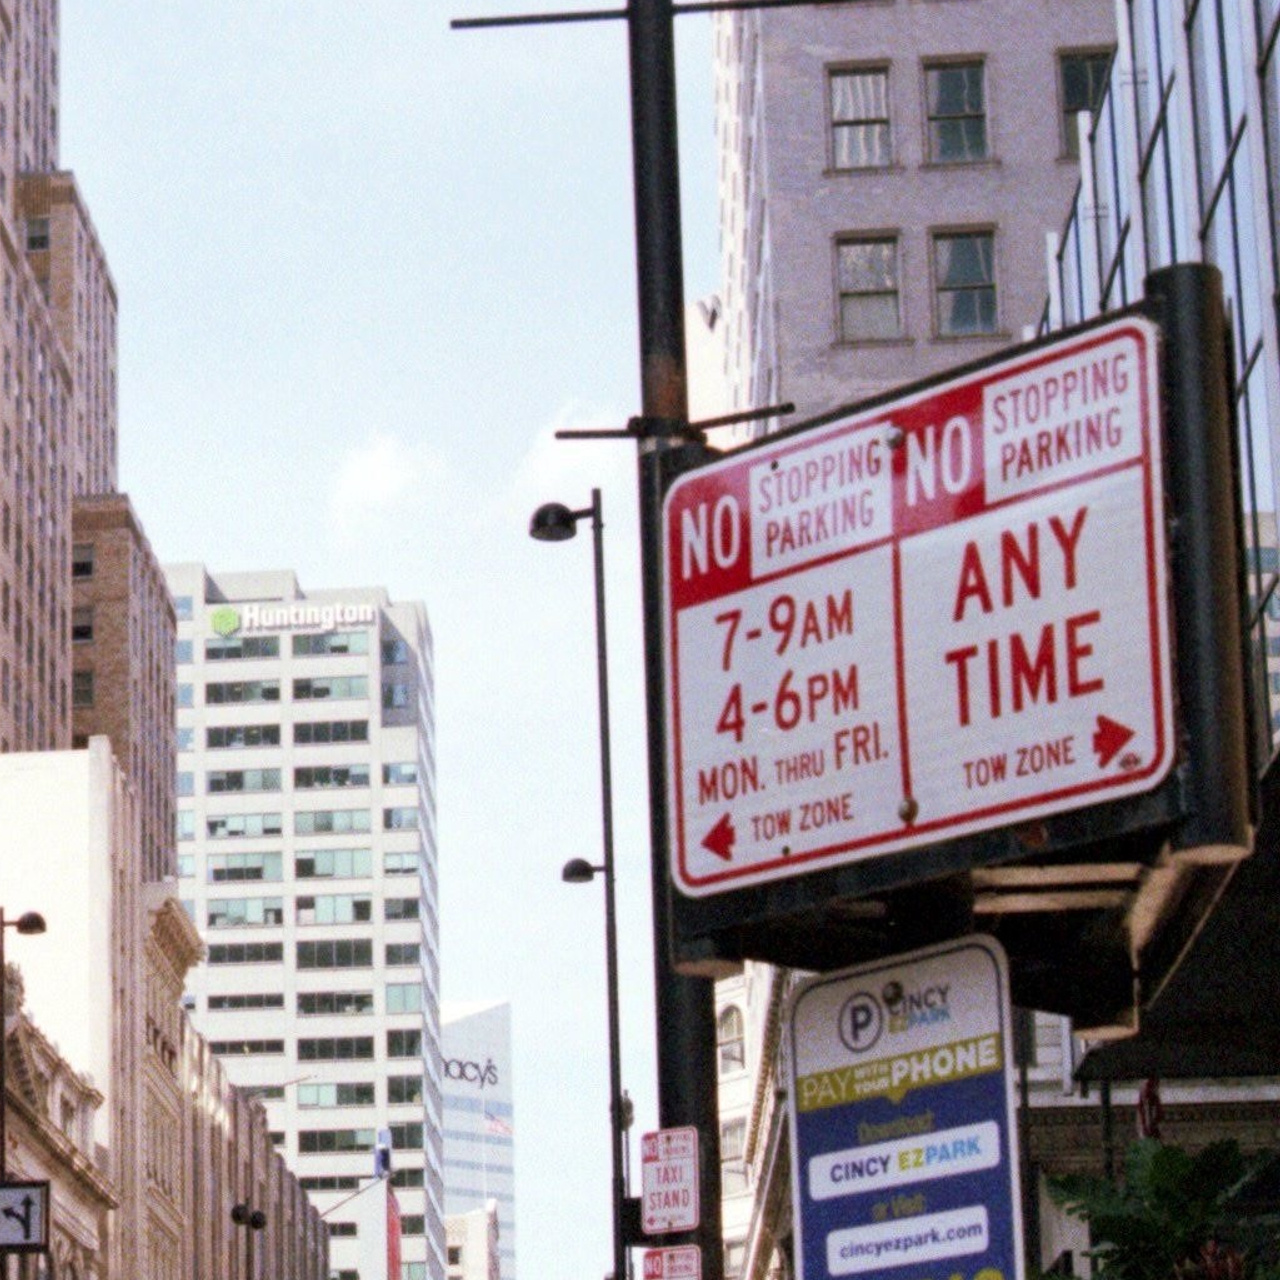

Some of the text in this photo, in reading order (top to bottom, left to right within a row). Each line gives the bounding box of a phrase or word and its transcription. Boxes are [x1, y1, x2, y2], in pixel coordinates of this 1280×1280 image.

[992, 354, 1129, 434] STOPPING
[758, 439, 882, 513] STOPPING
[905, 416, 973, 507] NO
[1001, 406, 1121, 483] PARKING
[681, 495, 741, 580] NO
[765, 490, 874, 558] PARKING
[952, 506, 1089, 621] ANY
[243, 604, 375, 631] Huntington
[715, 589, 854, 671] 7-9AM
[715, 664, 859, 743] 4-6PM
[945, 610, 1104, 727] TIME
[698, 721, 889, 805] MON. THRU FRI.
[962, 750, 1008, 790] TOW
[1016, 736, 1075, 777] ZONE
[750, 794, 854, 841] TOW ZONE
[803, 1071, 852, 1106] PAY
[892, 1038, 997, 1087] PHONE
[657, 1166, 682, 1184] TAXI
[830, 1136, 981, 1183] CINCY EZPARK
[649, 1189, 689, 1211] STAND
[646, 1256, 661, 1275] NO
[840, 1223, 983, 1259] cincyezpark.com
